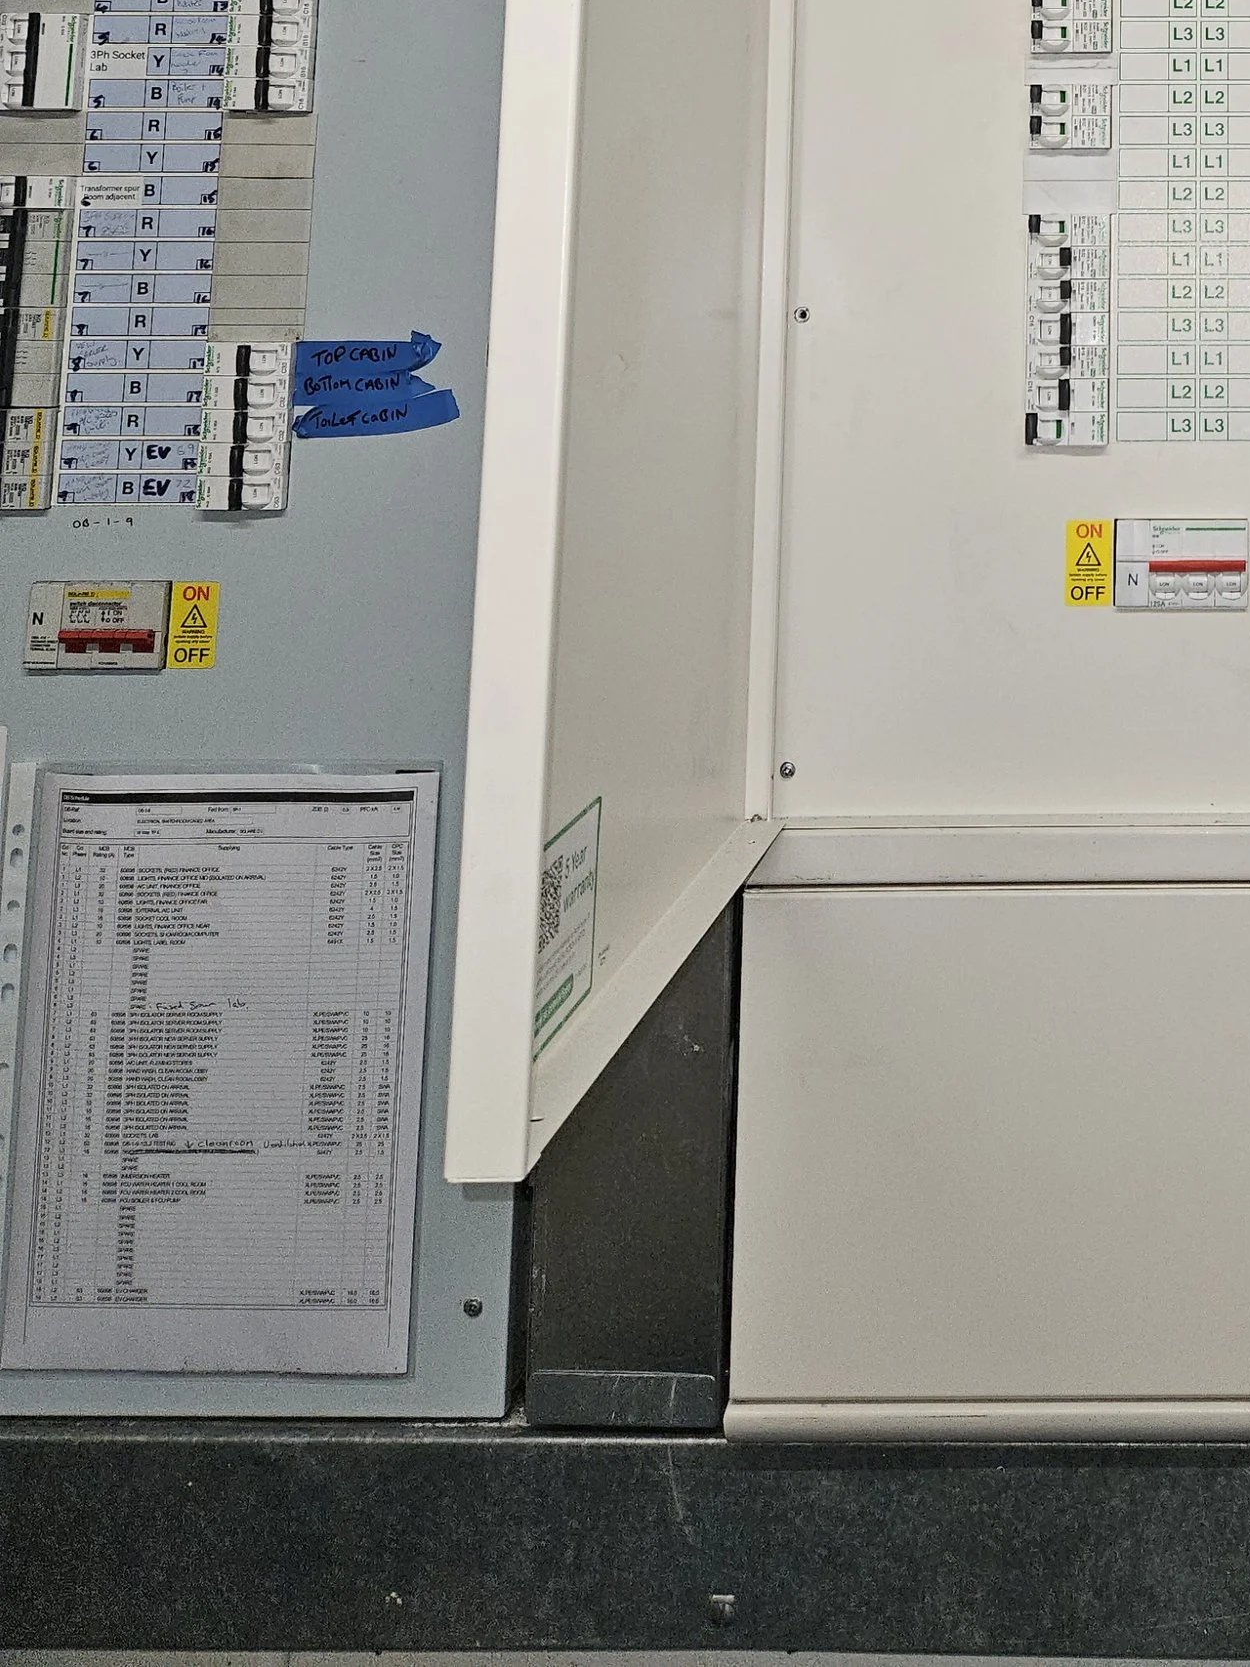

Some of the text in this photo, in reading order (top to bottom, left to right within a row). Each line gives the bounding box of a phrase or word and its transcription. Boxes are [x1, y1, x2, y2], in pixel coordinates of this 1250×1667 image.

[156, 24, 166, 35] R
[1173, 26, 1194, 42] L3
[1205, 26, 1225, 42] L3
[90, 50, 145, 60] 3Ph Socket
[153, 55, 165, 67] Y
[90, 63, 107, 72] Lab
[1172, 57, 1191, 73] L1
[1204, 57, 1223, 73] L1
[151, 87, 162, 99] B
[1172, 89, 1193, 105] L2
[1204, 89, 1225, 105] L2
[148, 120, 159, 131] R
[1172, 122, 1193, 137] L3
[1204, 122, 1225, 137] L3
[147, 152, 158, 164] Y
[1172, 154, 1191, 169] L1
[1204, 154, 1223, 169] L1
[105, 193, 135, 201] adjacent
[144, 184, 155, 196] B
[1172, 186, 1193, 202] L2
[1204, 186, 1225, 201] L2
[142, 217, 153, 229] R
[1172, 219, 1193, 234] L3
[1204, 218, 1225, 234] L3
[139, 249, 151, 261] Y
[1171, 251, 1190, 267] L1
[1204, 251, 1223, 267] L1
[137, 282, 148, 294] B
[1171, 284, 1193, 300] L2
[1204, 284, 1225, 300] L2
[135, 315, 146, 327] R
[1171, 317, 1192, 333] L3
[1204, 317, 1225, 333] L3
[132, 348, 144, 360] Y
[310, 344, 397, 367] TOP CABIN
[1171, 351, 1190, 366] L1
[1204, 351, 1223, 366] L1
[130, 381, 141, 394] B
[355, 374, 400, 392] CABIN
[1171, 384, 1192, 400] L2
[1203, 384, 1225, 400] L2
[128, 415, 139, 427] R
[1171, 417, 1192, 433] L3
[1203, 417, 1225, 433] L3
[125, 448, 137, 461] Y
[147, 445, 171, 460] EV
[122, 482, 134, 494] B
[143, 479, 171, 496] EV
[1076, 524, 1102, 539] ON
[1128, 574, 1138, 586] N
[183, 586, 210, 601] ON
[1071, 586, 1105, 600] OFF
[32, 612, 43, 625] N
[174, 648, 210, 662] OFF
